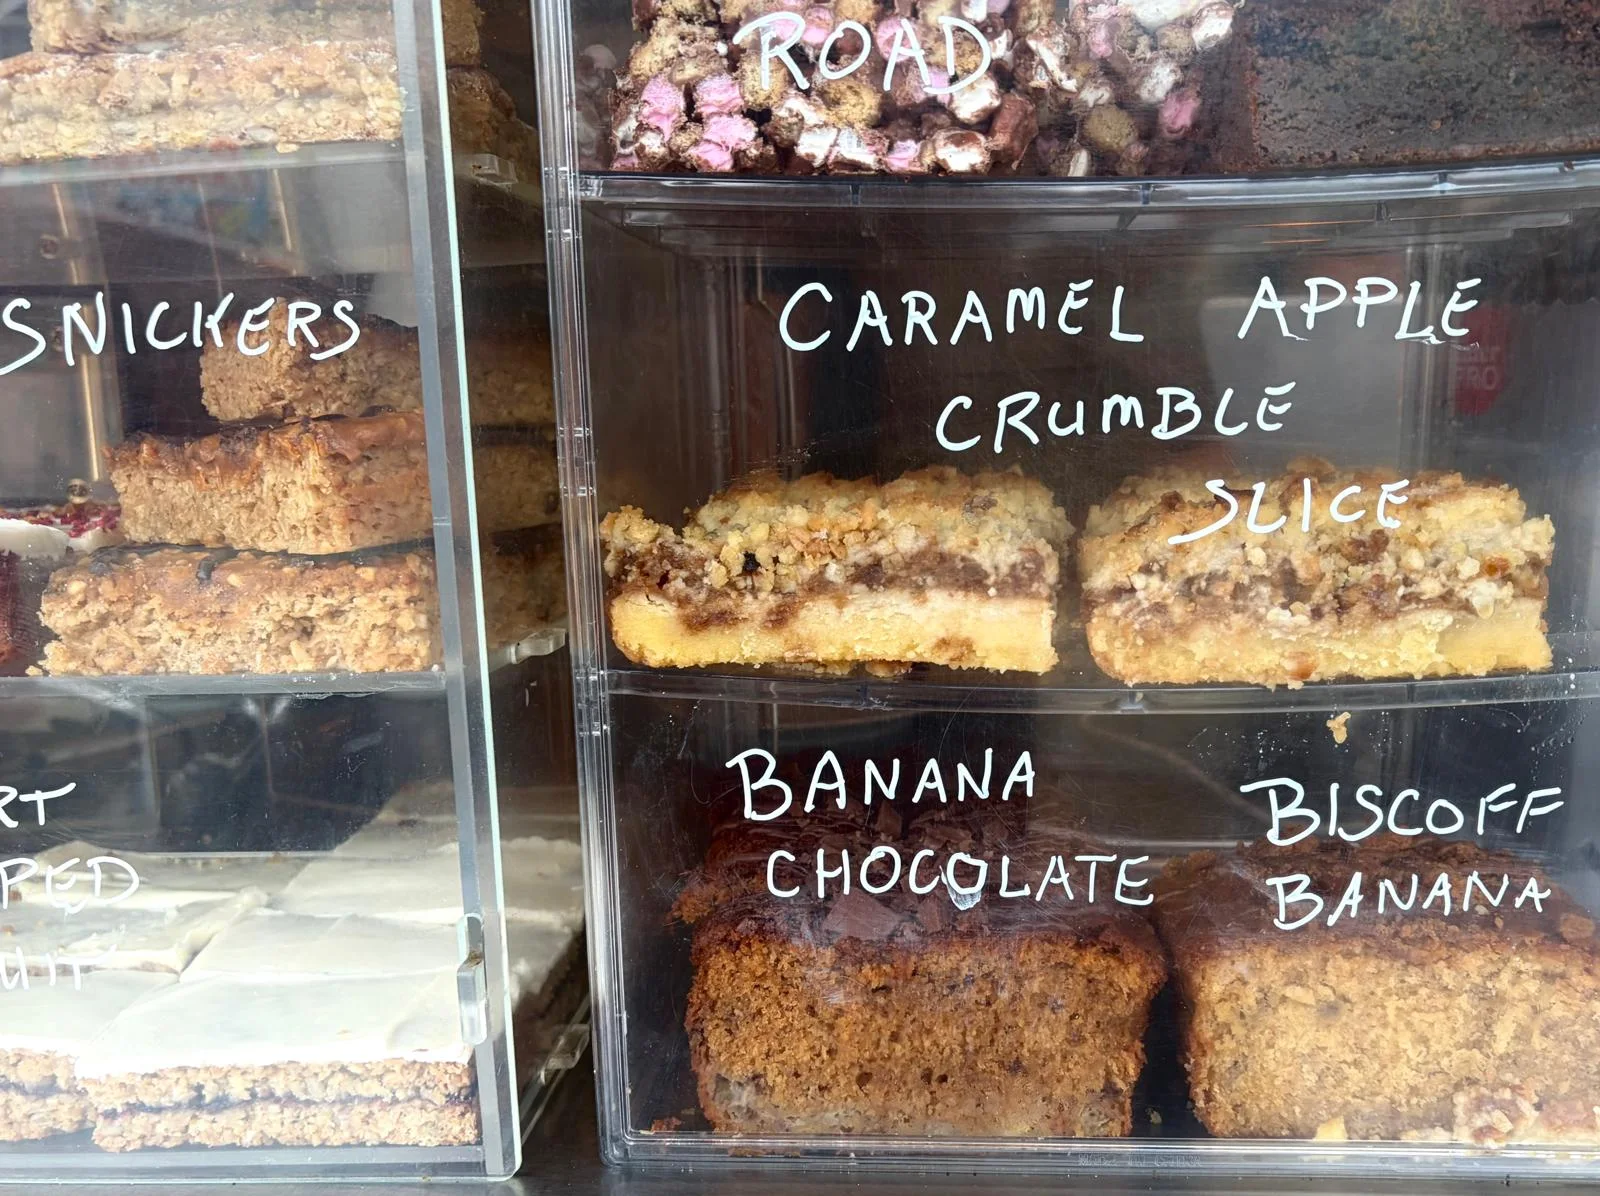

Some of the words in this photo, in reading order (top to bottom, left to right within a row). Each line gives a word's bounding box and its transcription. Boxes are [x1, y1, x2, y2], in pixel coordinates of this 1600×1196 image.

[733, 11, 992, 95] ROAD
[0, 291, 361, 376] SNICKERS
[779, 278, 1145, 353] CARAMEL
[1237, 276, 1483, 344] APPLE
[1168, 478, 1411, 547] SLICE
[725, 747, 1036, 822] BANANA
[1239, 777, 1565, 848] BISCOFF
[766, 846, 1155, 910] CHOCOLATE
[1265, 871, 1552, 931] BANANA
